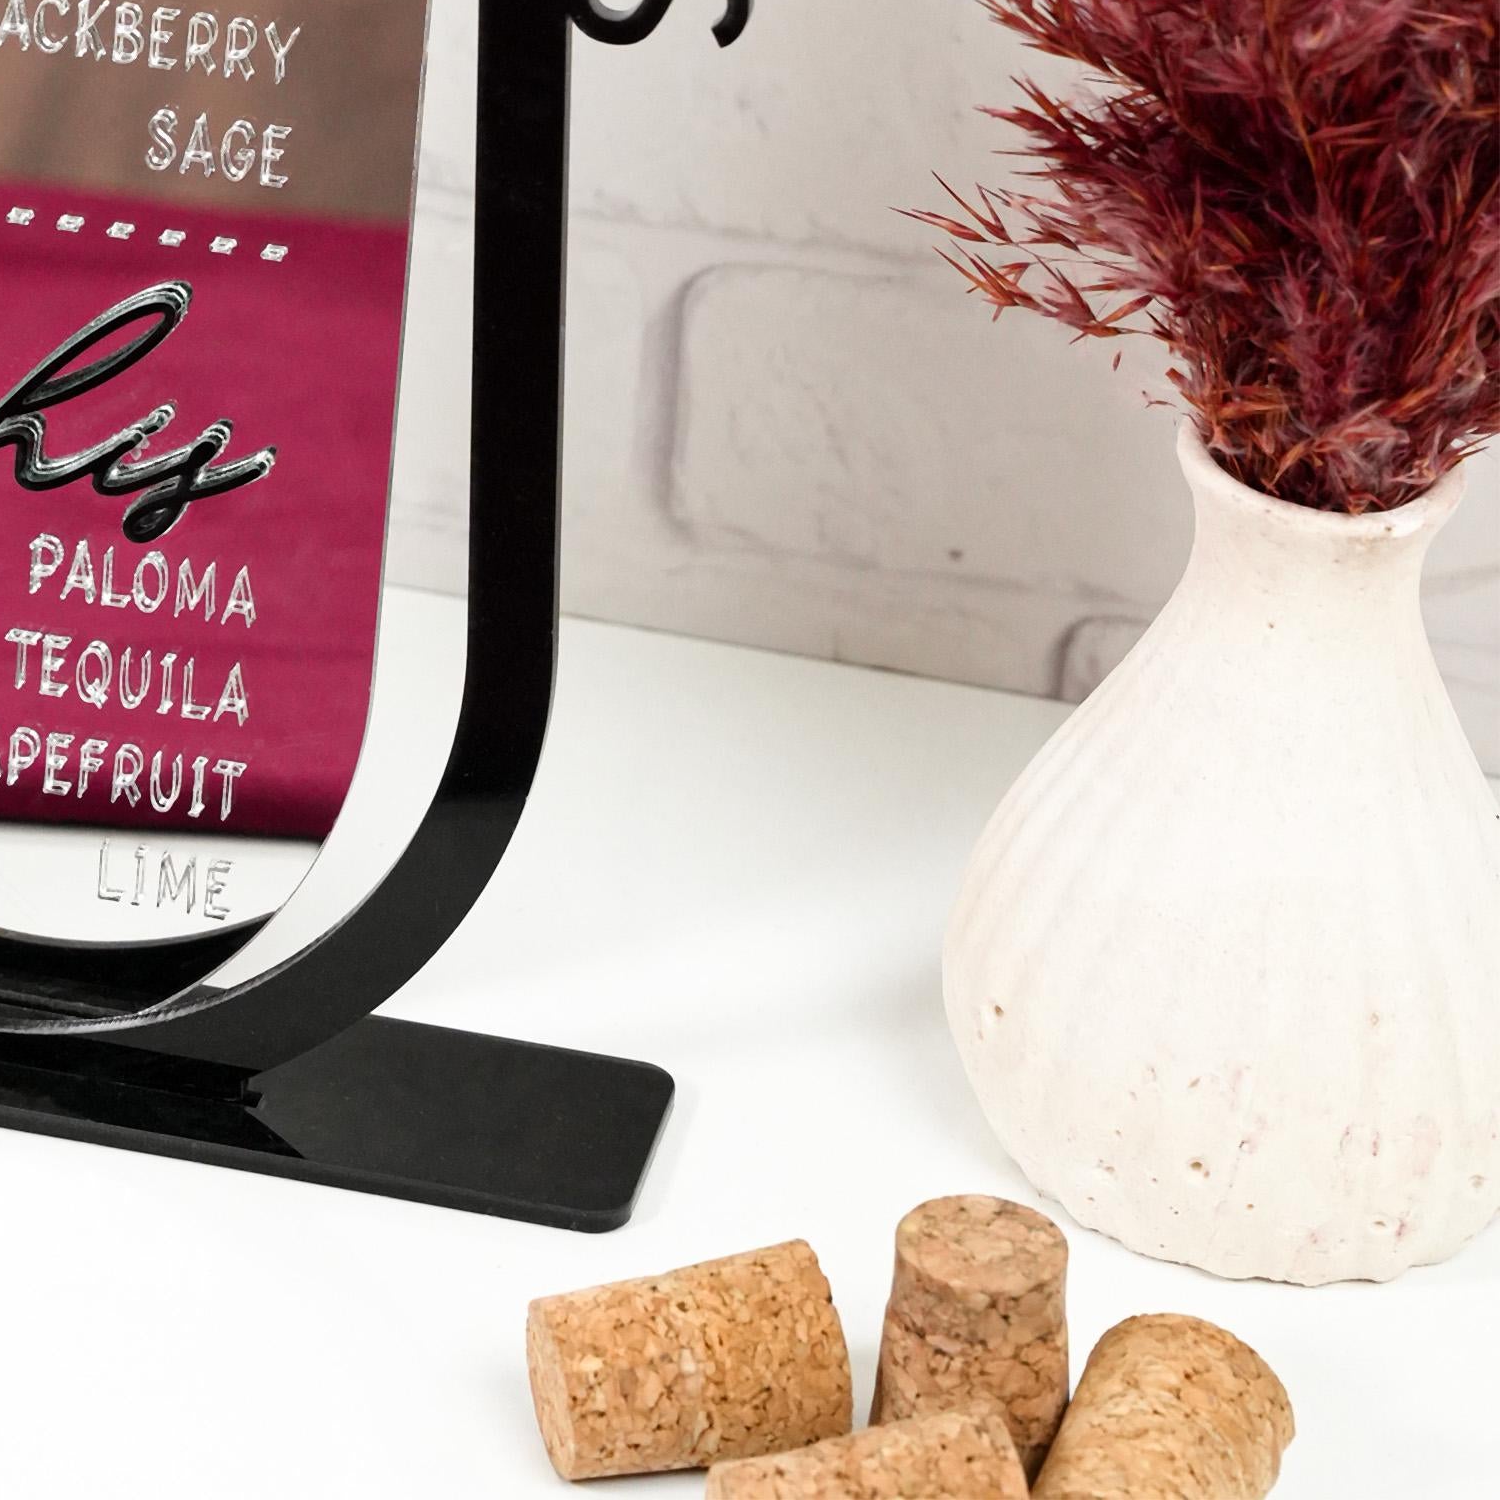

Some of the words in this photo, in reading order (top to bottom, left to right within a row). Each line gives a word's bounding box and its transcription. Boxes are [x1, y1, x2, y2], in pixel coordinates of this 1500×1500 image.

[145, 108, 292, 188] SAGE
[29, 533, 256, 628] PALOMA
[5, 628, 249, 726] TEQUILA
[97, 837, 232, 919] LIME
